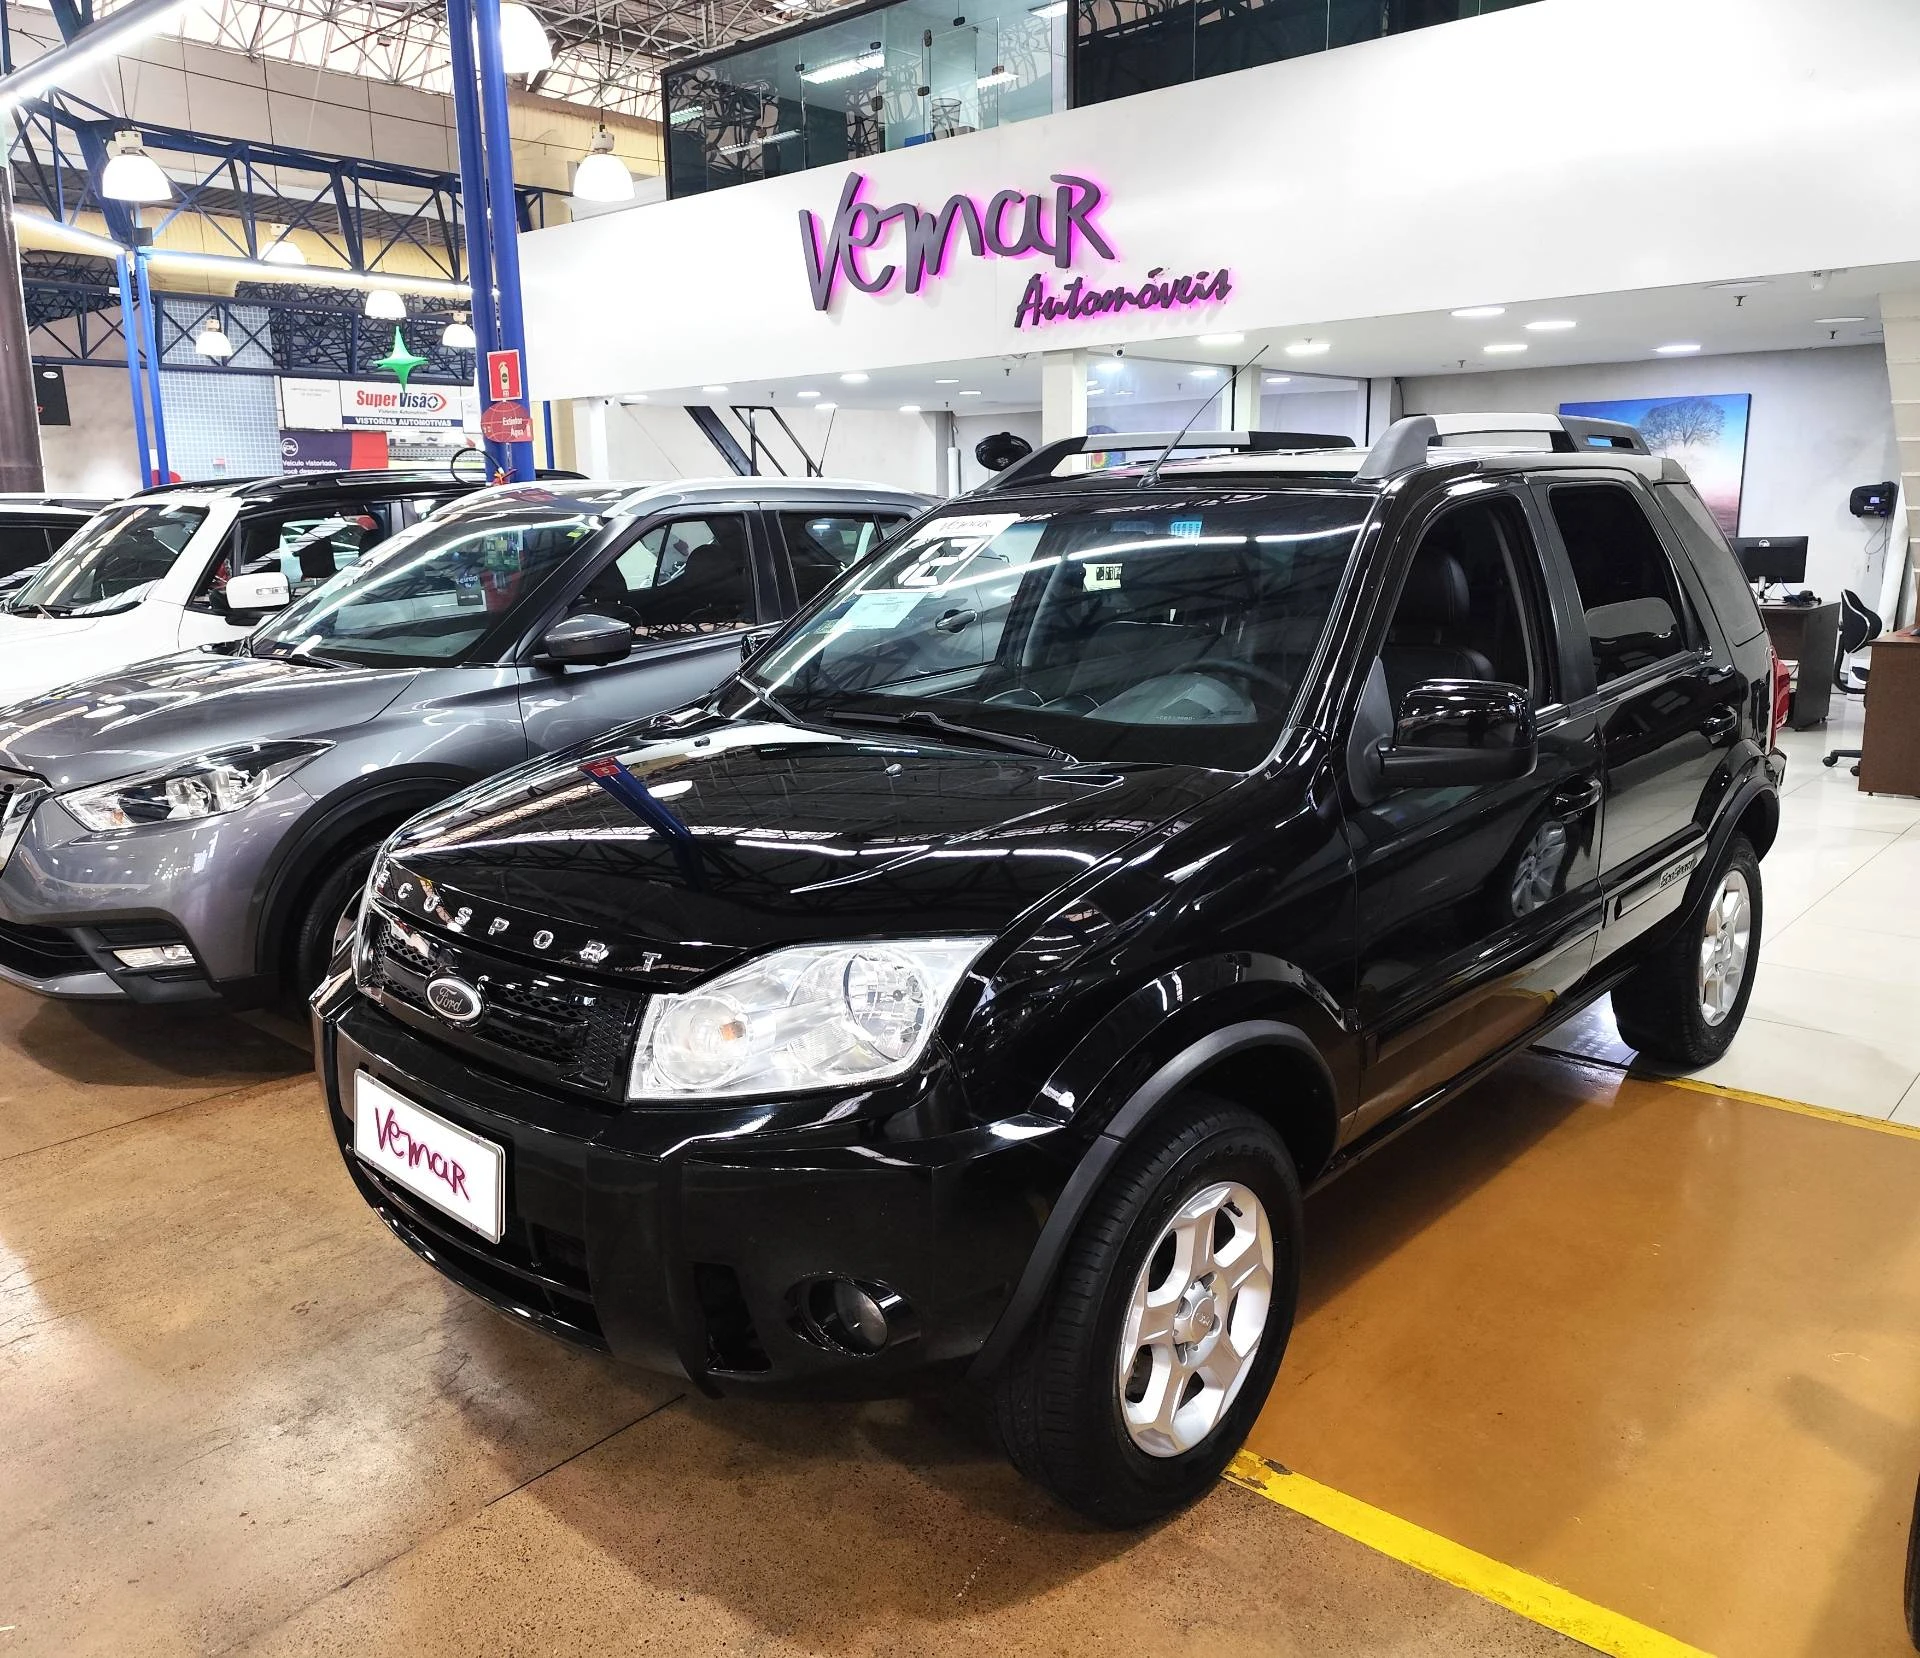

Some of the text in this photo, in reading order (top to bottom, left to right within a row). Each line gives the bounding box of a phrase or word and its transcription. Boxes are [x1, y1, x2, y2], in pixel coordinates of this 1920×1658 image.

[1013, 267, 1232, 329] Automóveis
[356, 390, 397, 407] Super
[355, 417, 452, 427] VISTORIAS AUTOMOTIVAS
[435, 986, 464, 1013] Ford
